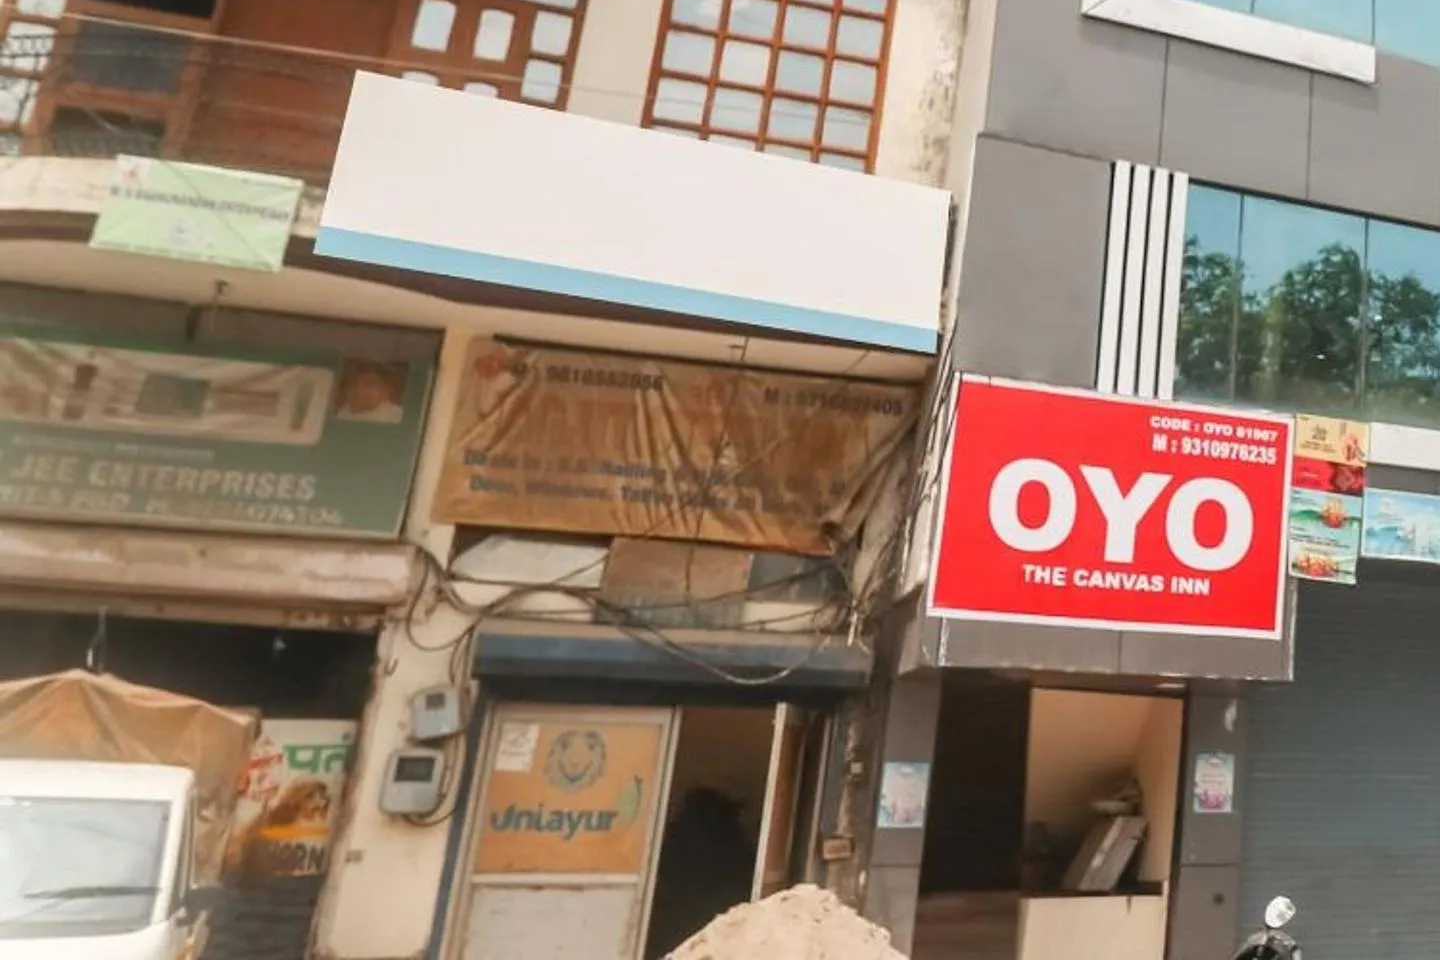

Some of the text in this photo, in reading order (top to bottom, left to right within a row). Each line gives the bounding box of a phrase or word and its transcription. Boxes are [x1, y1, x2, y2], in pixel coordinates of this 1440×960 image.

[1150, 415, 1192, 431] CODE
[1203, 421, 1234, 437] OYO
[88, 460, 318, 501] ENTERPRISES
[988, 457, 1254, 572] OYO
[1022, 563, 1210, 596] THE CANVAS INN
